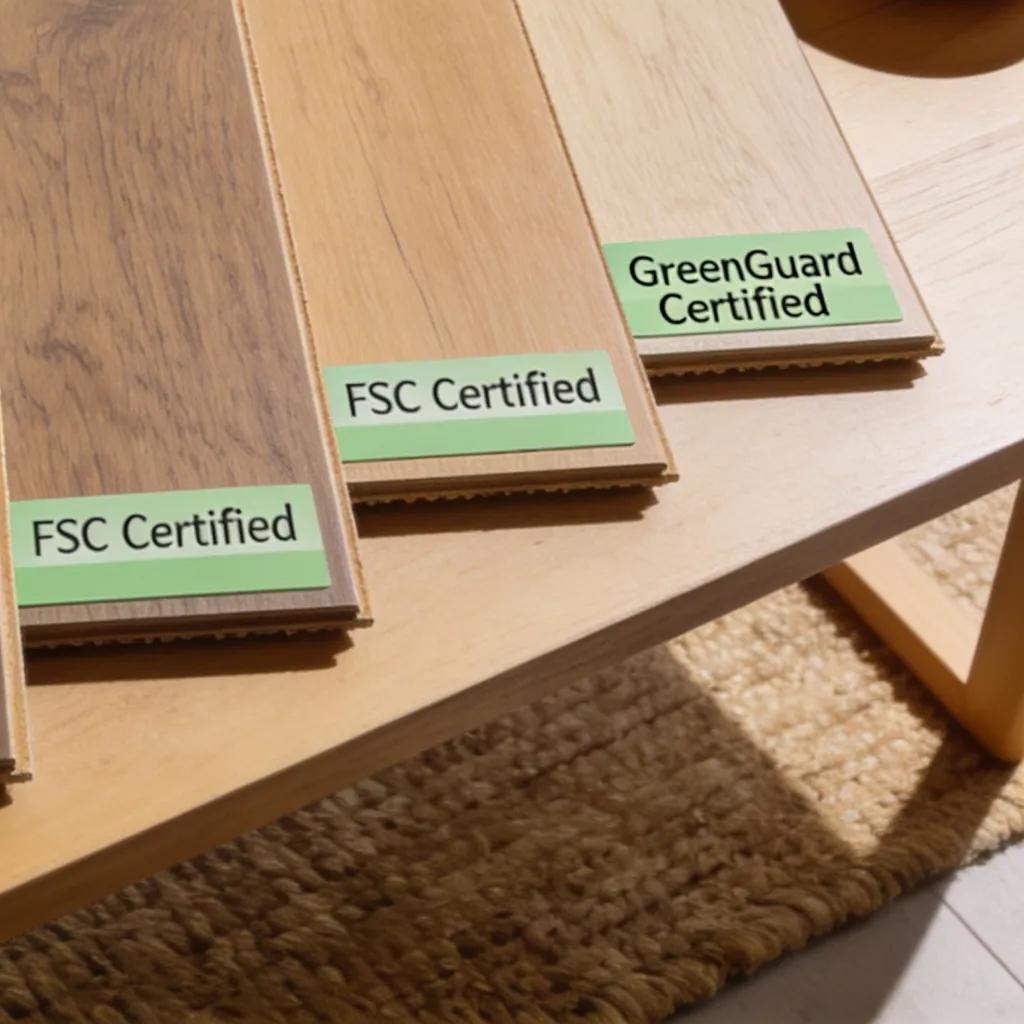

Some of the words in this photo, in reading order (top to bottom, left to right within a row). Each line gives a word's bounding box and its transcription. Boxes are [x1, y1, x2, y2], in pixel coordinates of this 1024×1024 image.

[628, 241, 863, 287] GreenGuard
[659, 282, 830, 325] Certified
[345, 380, 421, 417] FSC
[432, 367, 601, 411] Certified
[32, 516, 108, 557] FSC
[122, 502, 297, 550] Certified
